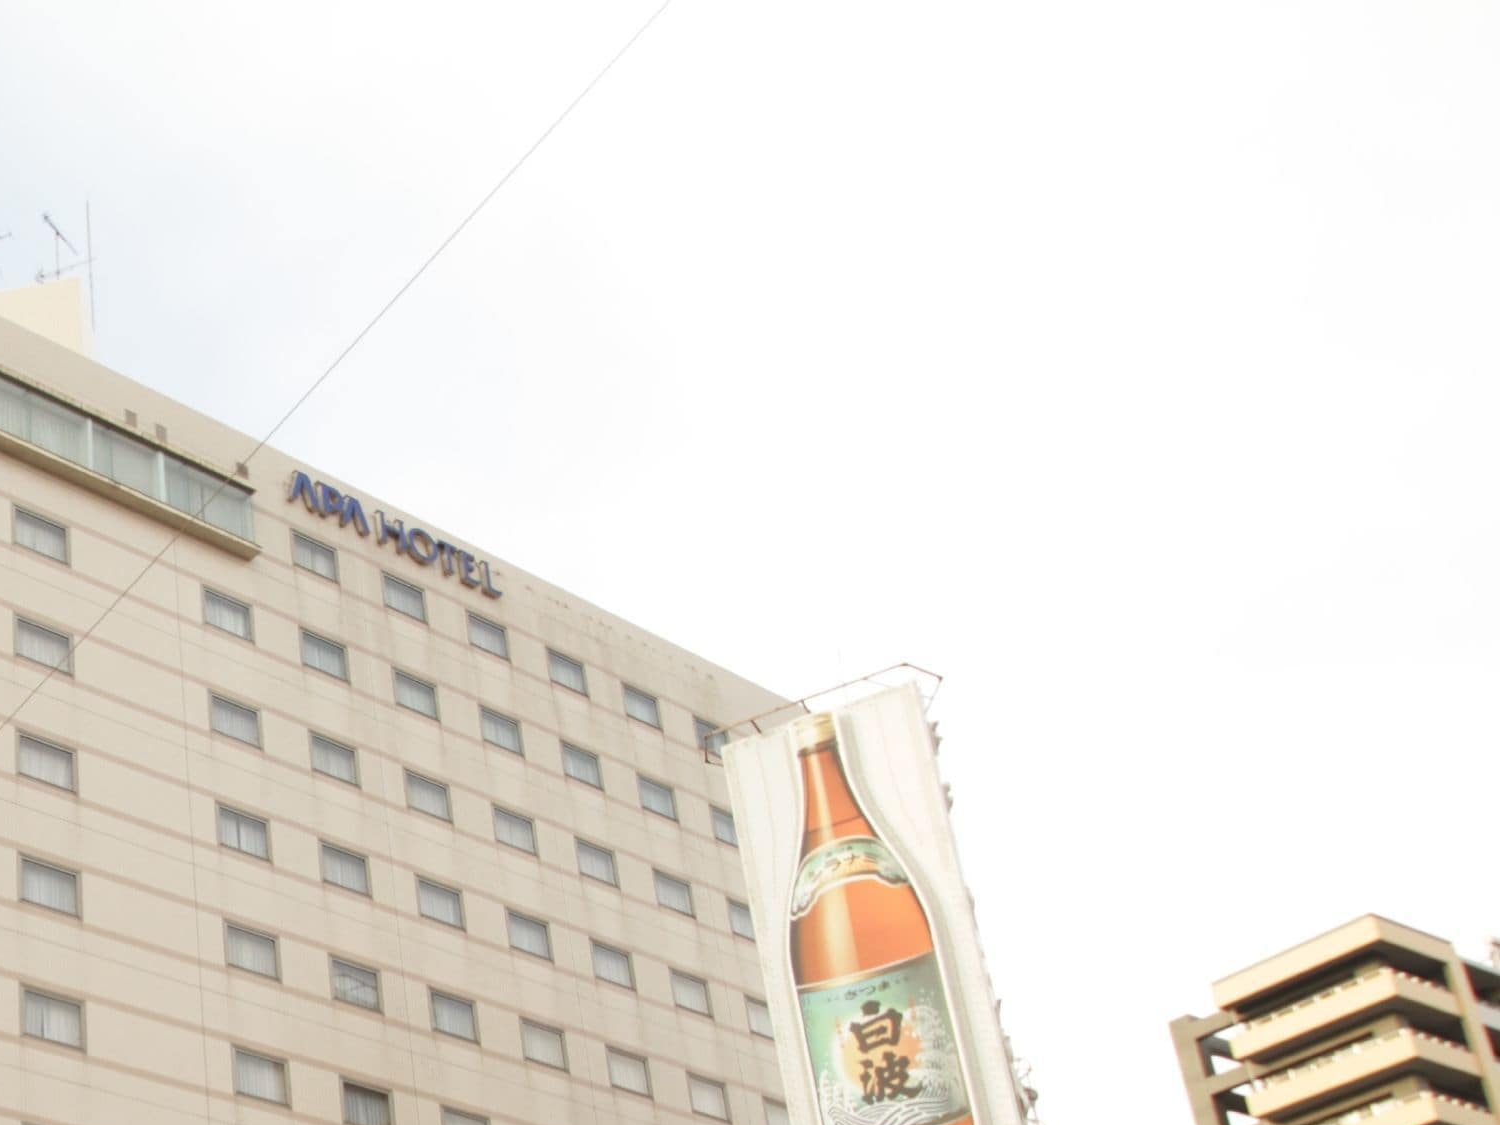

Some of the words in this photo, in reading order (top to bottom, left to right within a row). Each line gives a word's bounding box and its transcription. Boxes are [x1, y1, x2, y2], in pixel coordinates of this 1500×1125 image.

[287, 470, 370, 538] APA
[373, 509, 502, 599] HOTEL
[850, 1000, 923, 1105] 白波
